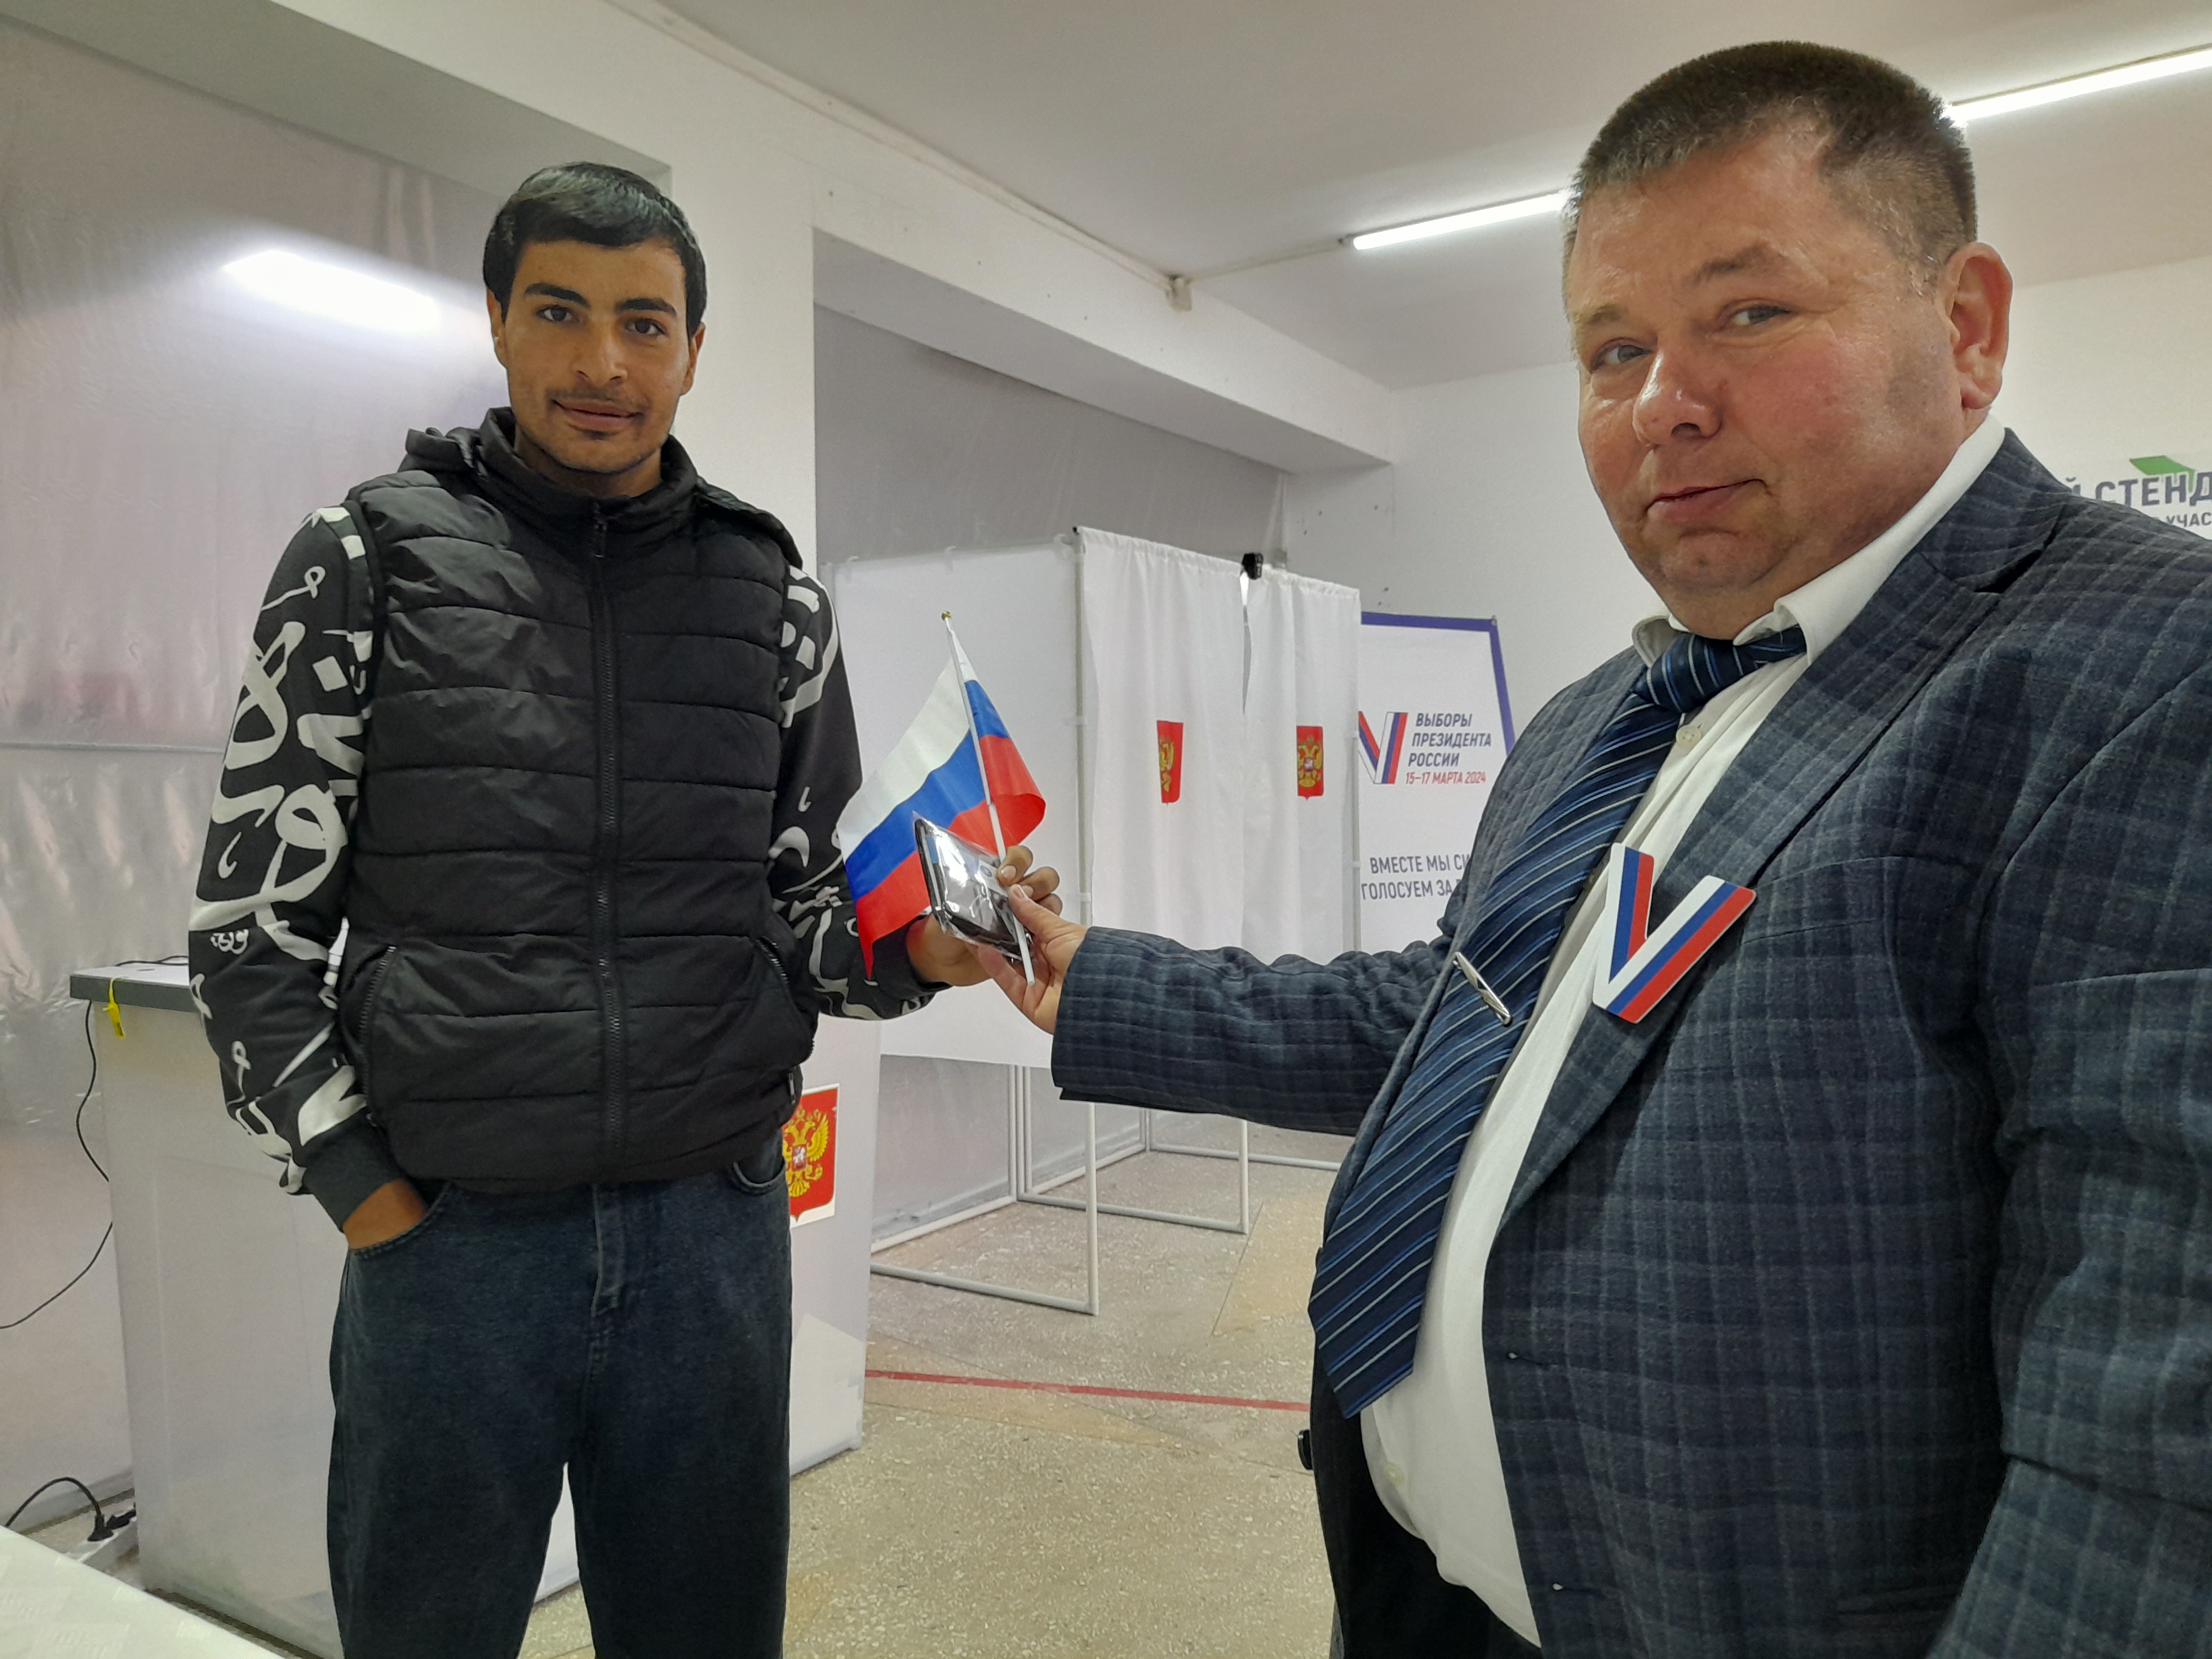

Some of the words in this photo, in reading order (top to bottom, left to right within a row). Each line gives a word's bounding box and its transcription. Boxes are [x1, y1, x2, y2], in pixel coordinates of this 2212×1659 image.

[2095, 471, 2212, 507] СТЕНД
[1415, 713, 1473, 727] ВЫБОРЫ
[1411, 732, 1491, 749] ПРЕЗИДЕНТА
[1408, 752, 1460, 767] РОССИИ
[1432, 771, 1463, 784] МАРТА
[1464, 771, 1486, 784] 2024
[1370, 855, 1423, 874] ВМЕСТЕ
[1426, 854, 1451, 872] МЫ
[1361, 880, 1433, 900] ГОЛОСУЕМ
[1436, 879, 1453, 896] ЗА
